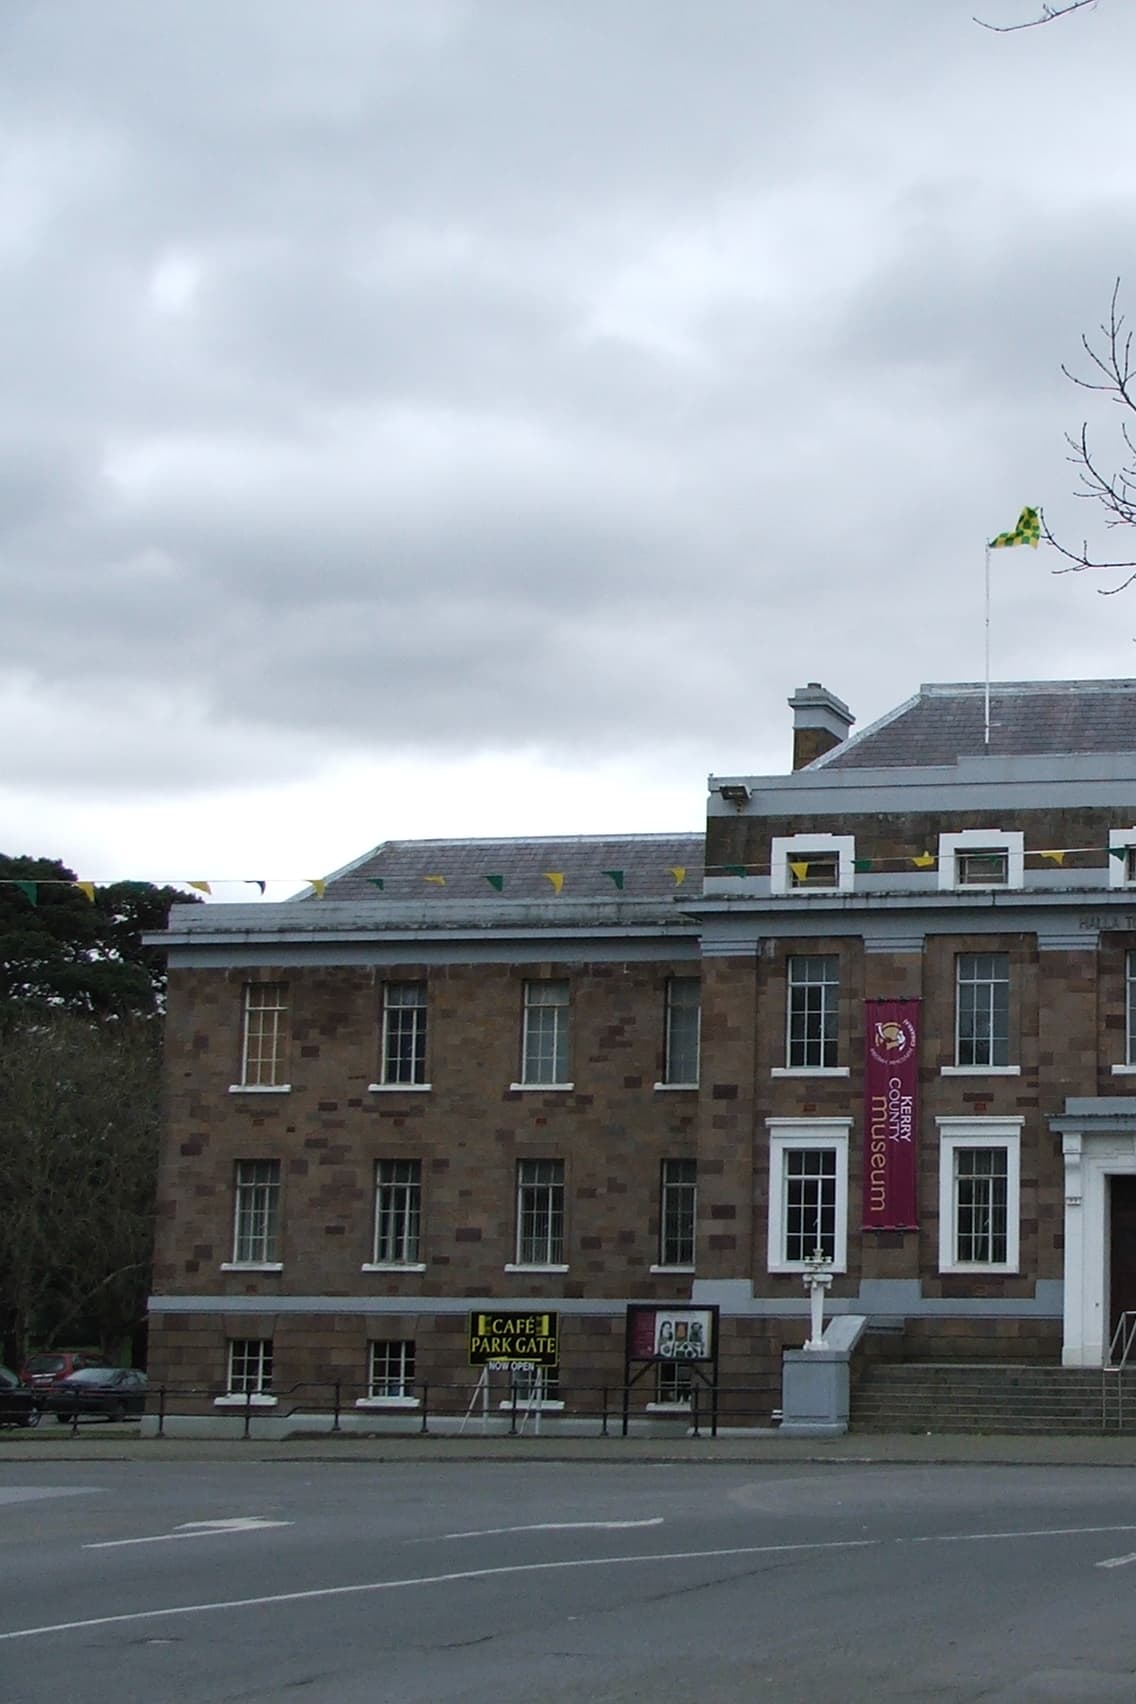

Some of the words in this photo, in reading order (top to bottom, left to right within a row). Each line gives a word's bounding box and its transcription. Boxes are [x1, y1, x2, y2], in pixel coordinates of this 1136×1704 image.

[889, 1077, 901, 1143] COUNTY
[901, 1096, 912, 1142] KERRY
[870, 1096, 887, 1211] museum
[492, 1315, 535, 1334] CAFÉ
[471, 1337, 512, 1353] PARK
[515, 1337, 556, 1353] GATE
[488, 1361, 510, 1371] NOW
[510, 1361, 535, 1371] OPEN
